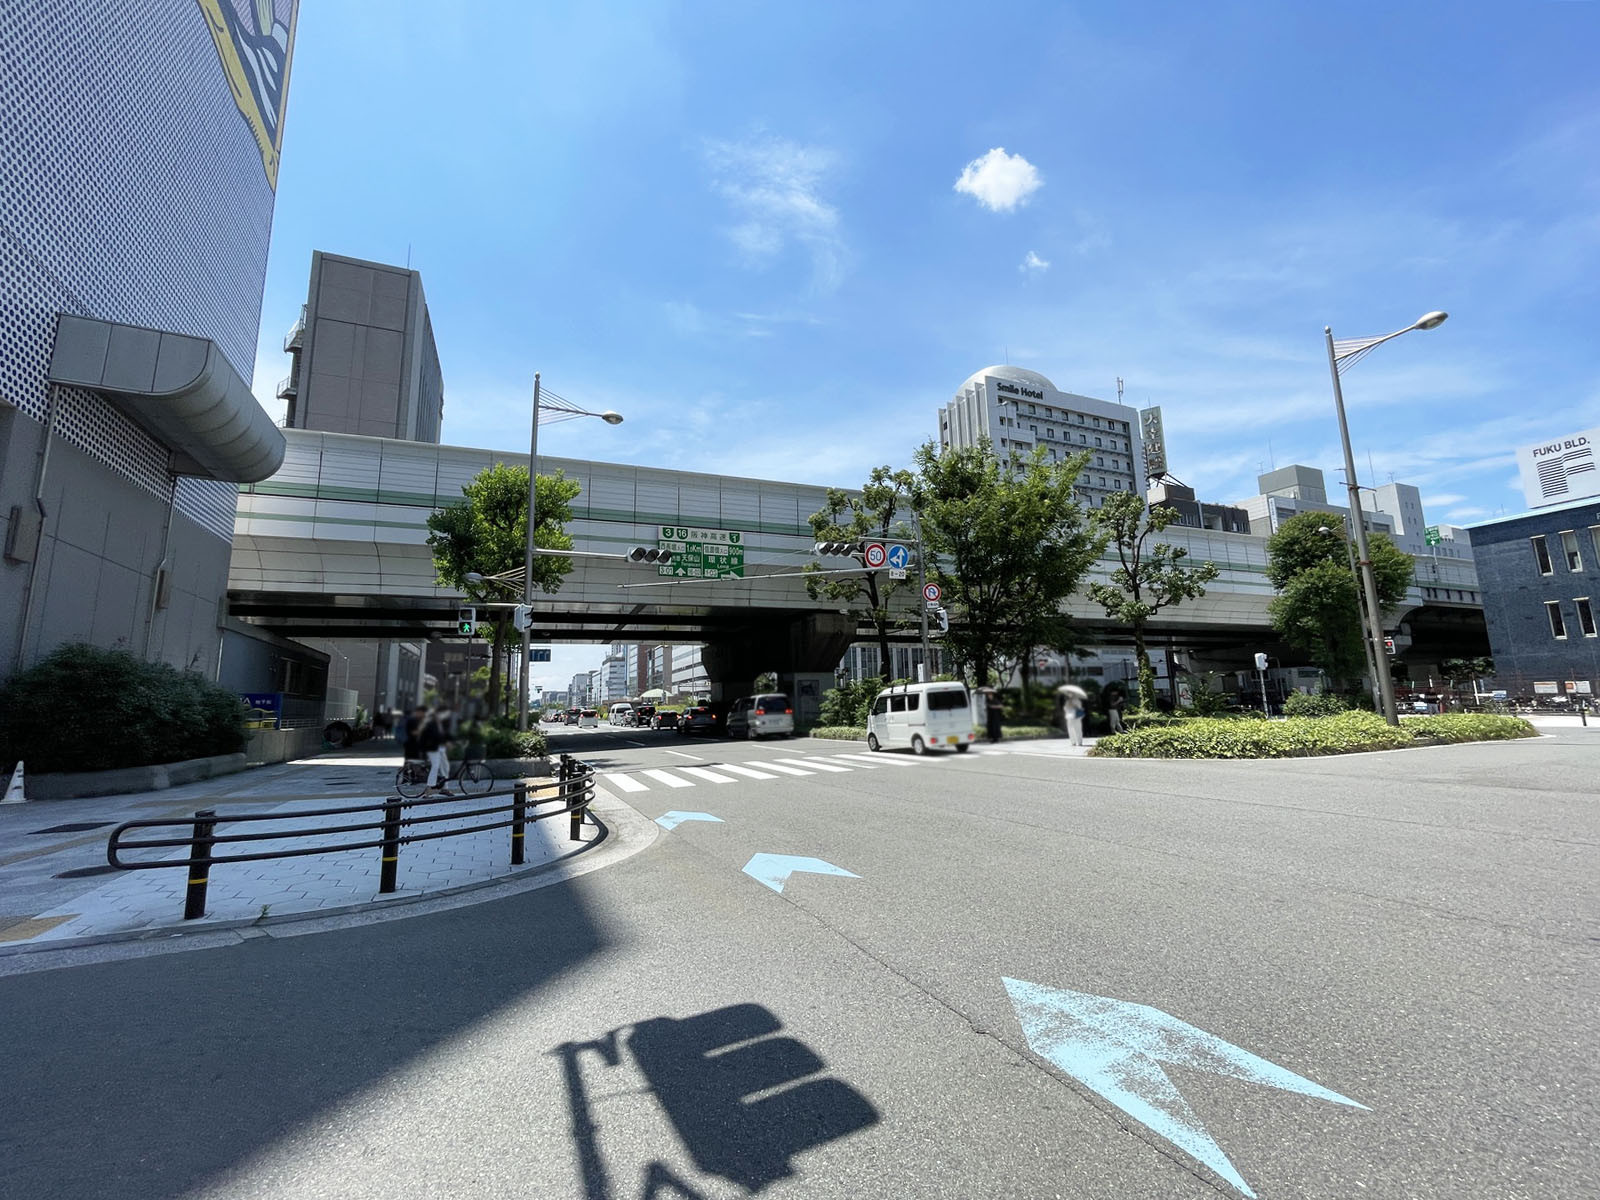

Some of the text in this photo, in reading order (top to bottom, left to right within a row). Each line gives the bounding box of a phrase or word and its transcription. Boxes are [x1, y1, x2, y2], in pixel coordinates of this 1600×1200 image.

[997, 382, 1043, 400] Smile Hotel
[1533, 437, 1590, 458] FUKU BLD.
[665, 528, 672, 537] 3
[678, 529, 687, 538] 16
[691, 531, 726, 541] 阪神高速
[870, 551, 882, 561] 50
